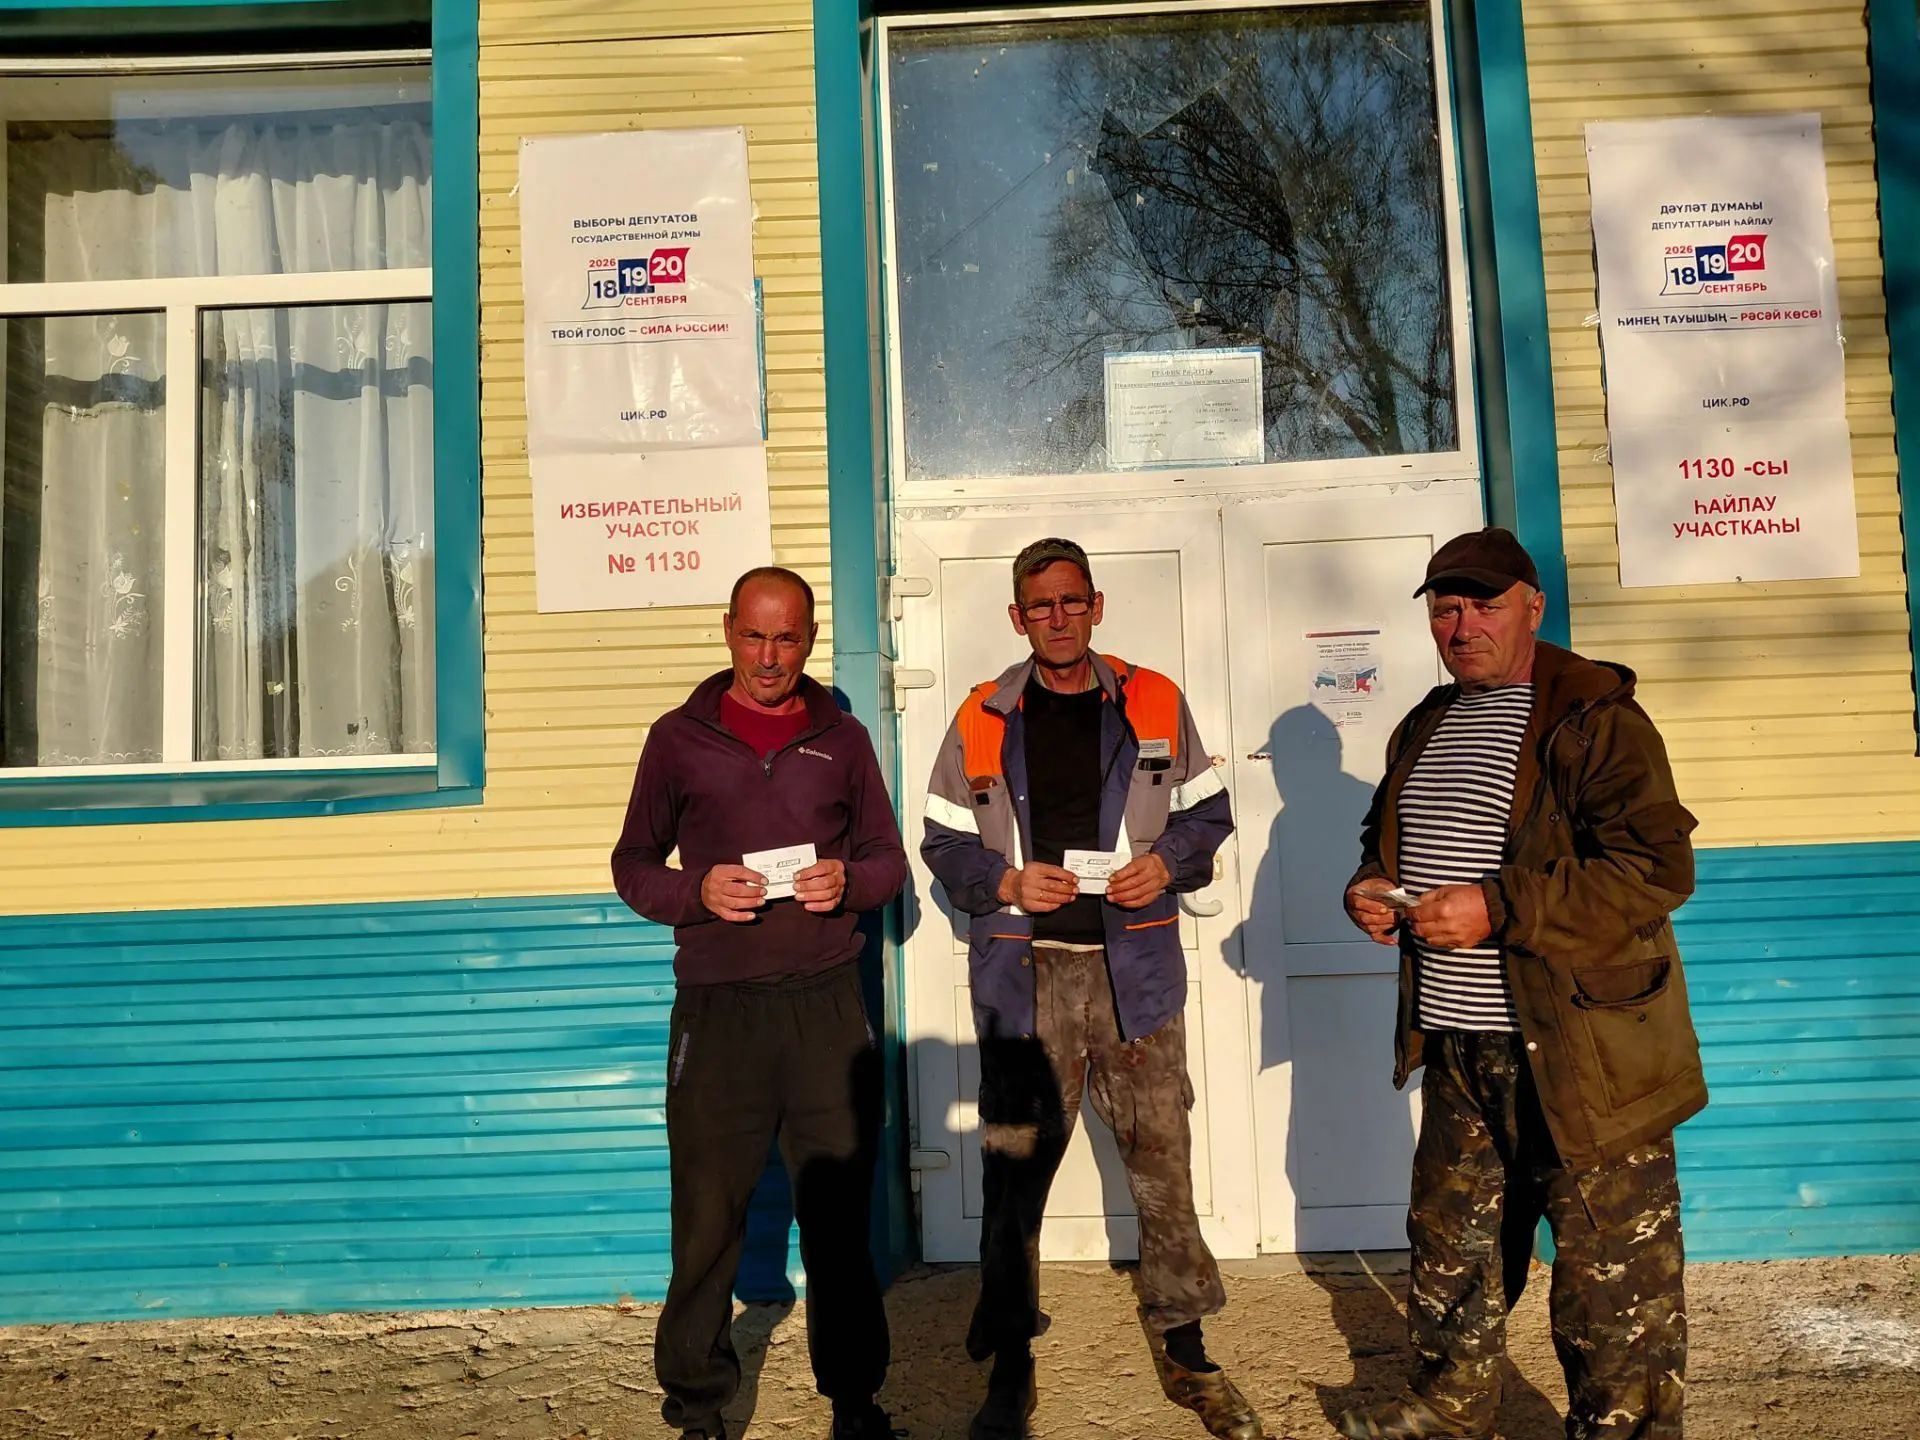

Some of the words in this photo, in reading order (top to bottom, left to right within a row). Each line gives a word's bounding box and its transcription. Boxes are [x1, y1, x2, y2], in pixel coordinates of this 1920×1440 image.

[1660, 203, 1708, 215] ДӘҮЛӘТ
[1711, 201, 1763, 213] ДУМАҺЫ
[573, 216, 626, 229] ВЫБОРЫ
[628, 214, 698, 227] ДЕПУТАТОВ
[1651, 218, 1731, 231] ДЕПУТАТТАРЫН
[1733, 217, 1774, 227] ҺАЙЛАУ
[571, 230, 669, 244] ГОСУДАРСТВЕННОЙ
[670, 230, 701, 241] ДУМЫ
[1664, 245, 1693, 255] 2026
[588, 258, 617, 268] 2026
[1670, 267, 1697, 286] 18
[1699, 254, 1726, 275] 19
[1730, 243, 1761, 264] 20
[592, 279, 618, 300] 18
[621, 267, 647, 288] 19
[651, 256, 683, 277] 20
[1704, 282, 1767, 294] СЕНТЯБРЬ
[625, 295, 688, 307] СЕНТЯБРЯ
[1617, 313, 1660, 327] ҺИНЕҢ
[1662, 312, 1727, 326] ТАУЫШЫҢ
[1740, 309, 1782, 322] РӘСӘЙ
[1784, 310, 1822, 321] КӨСӨ!
[551, 327, 584, 340] ТВОЙ
[586, 326, 626, 339] ГОЛОС
[640, 325, 672, 336] СИЛА
[675, 323, 729, 335] РОССИИ!
[1702, 397, 1750, 409] ЦИК.РФ
[620, 410, 667, 422] ЦИК.РФ
[1678, 457, 1735, 480] 1130
[560, 491, 742, 519] ИЗБИРАТЕЛЬНЫЙ
[1694, 494, 1777, 515] ҺАЙЛАУ
[605, 520, 700, 539] УЧАСТОК
[1673, 517, 1800, 538] УЧАСТКАҺЫ
[608, 554, 636, 574] №
[645, 550, 700, 572] 1130
[805, 749, 833, 760] Columbia
